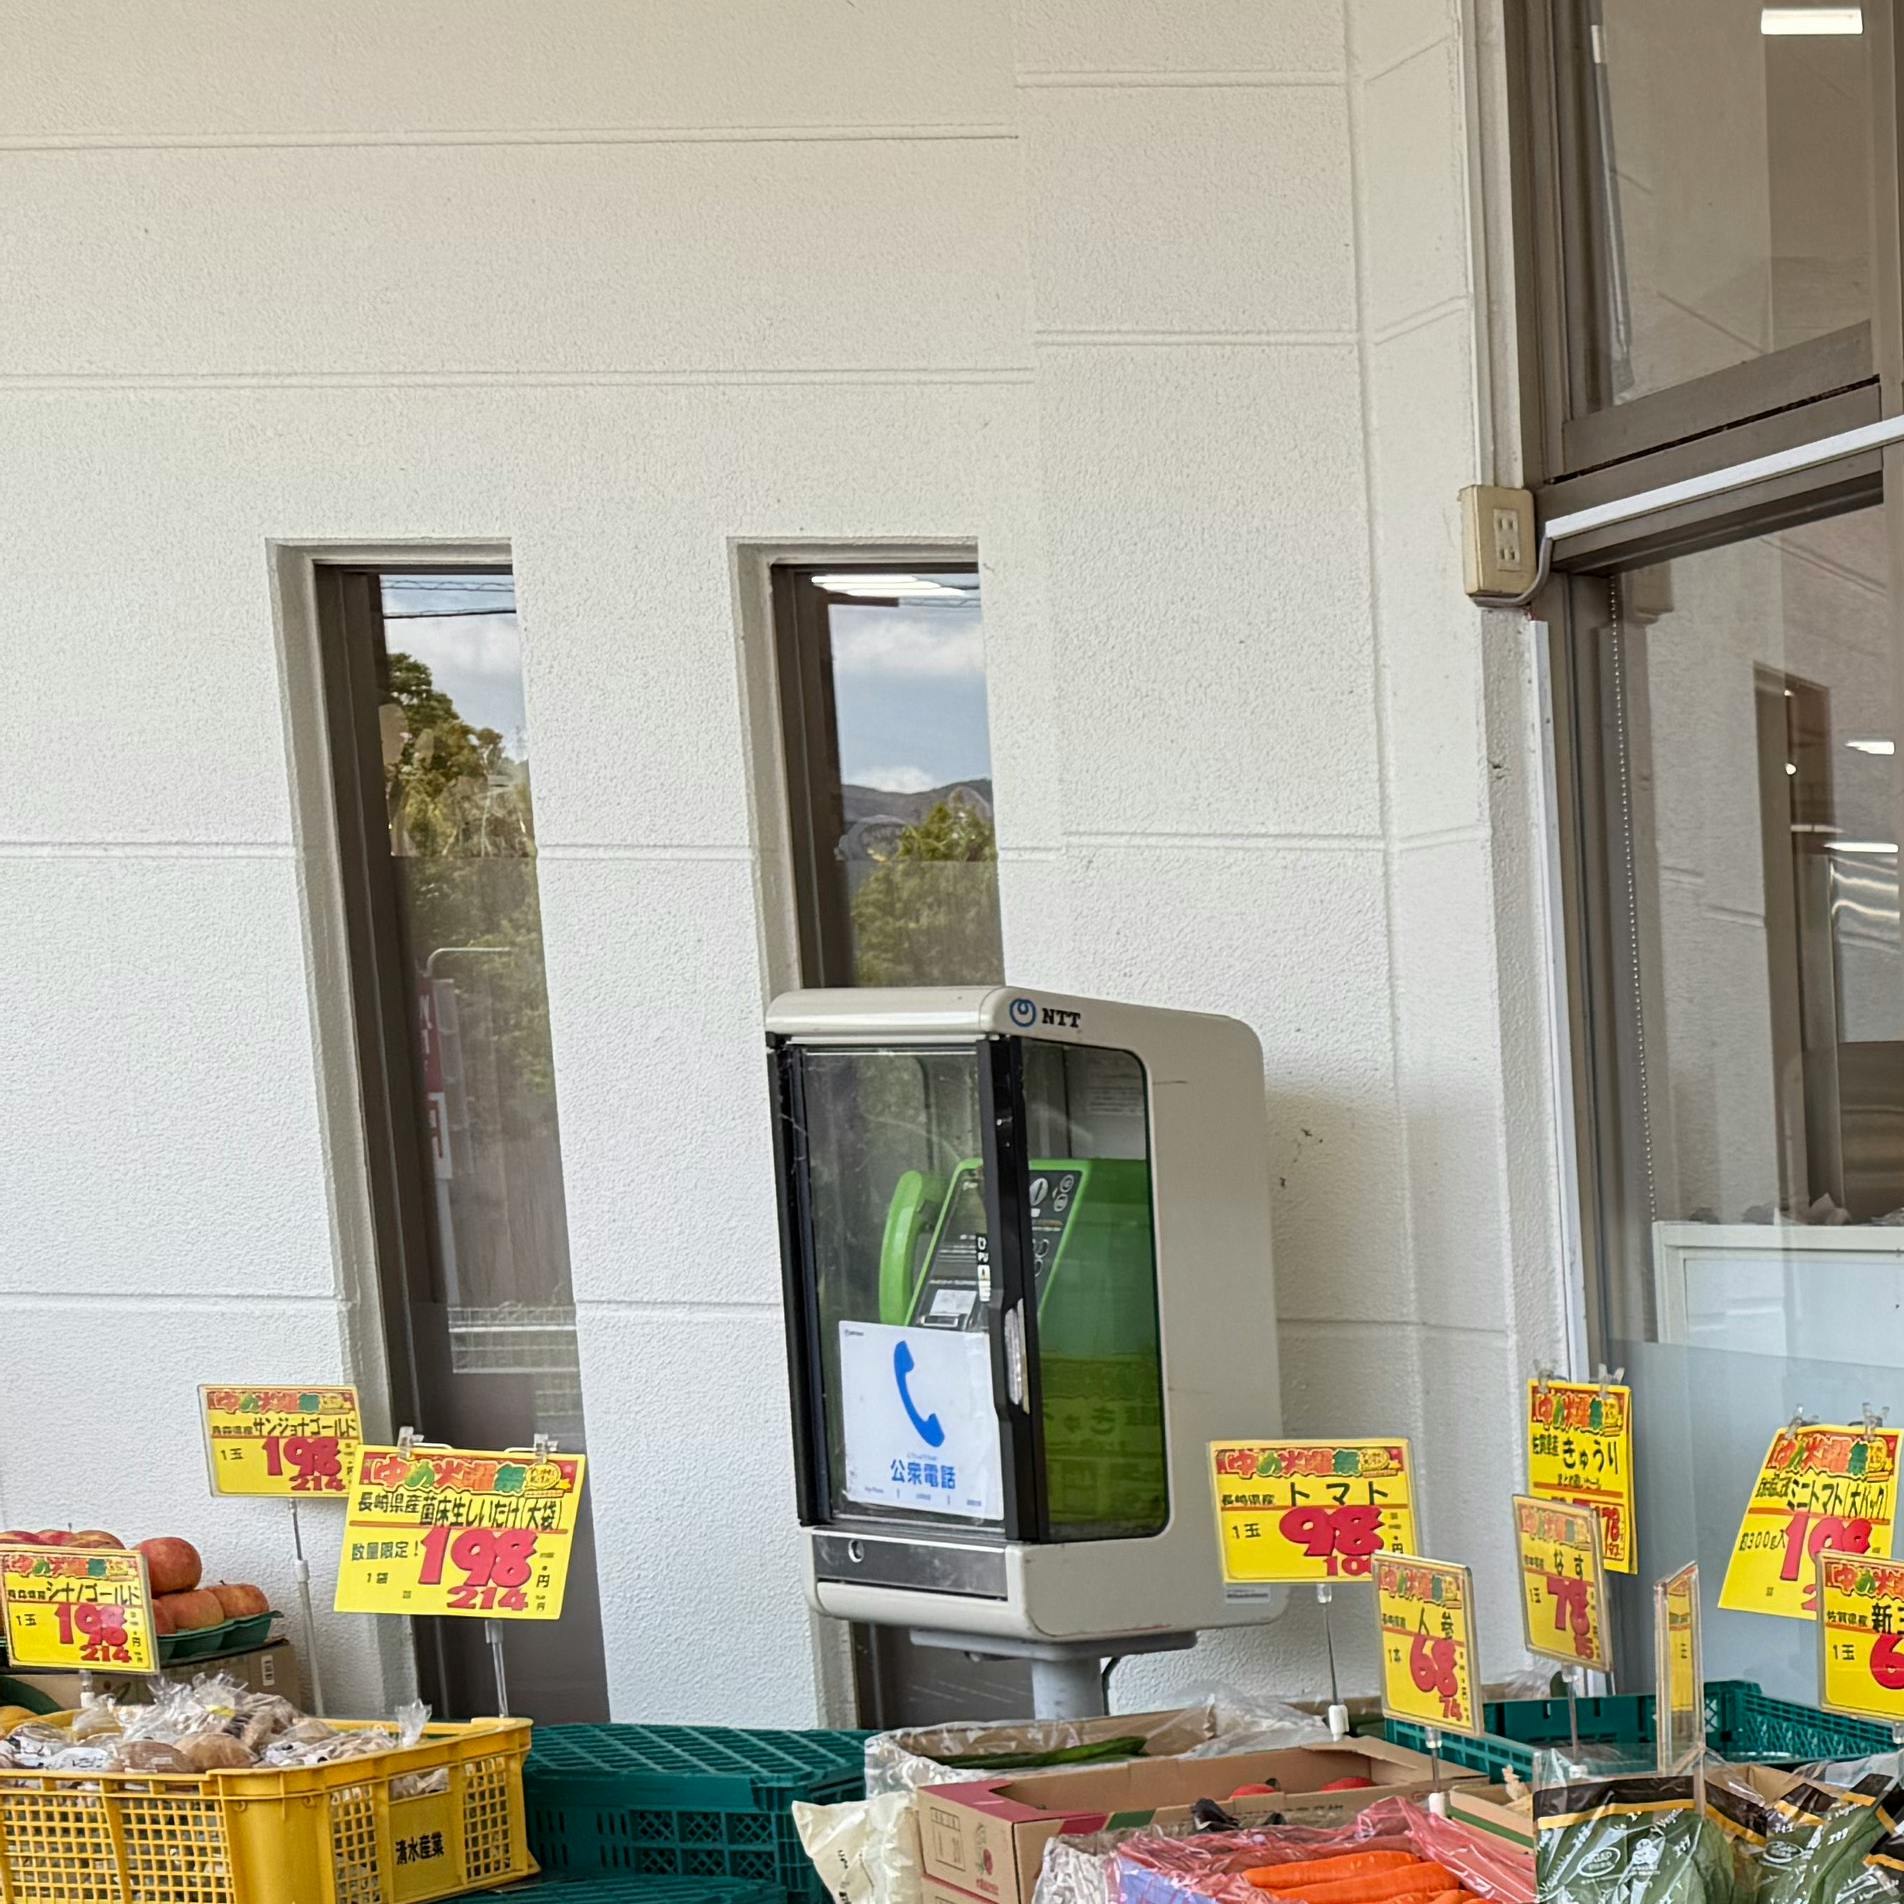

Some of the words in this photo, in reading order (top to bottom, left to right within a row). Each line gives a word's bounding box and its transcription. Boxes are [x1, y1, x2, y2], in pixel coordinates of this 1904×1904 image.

[1041, 1007, 1081, 1029] NTT
[262, 1436, 342, 1476] 198
[1562, 1439, 1620, 1474] きゅうり
[289, 1475, 346, 1491] 214
[890, 1459, 956, 1489] 公衆電話
[1290, 1481, 1388, 1507] トマト
[1279, 1506, 1386, 1557] 98
[418, 1527, 539, 1588] 198
[1323, 1556, 1373, 1576] 10
[446, 1586, 528, 1611] 214
[1547, 1576, 1590, 1635] 78
[55, 1603, 128, 1647] 198
[80, 1645, 132, 1663] 214
[1410, 1634, 1458, 1698] 68
